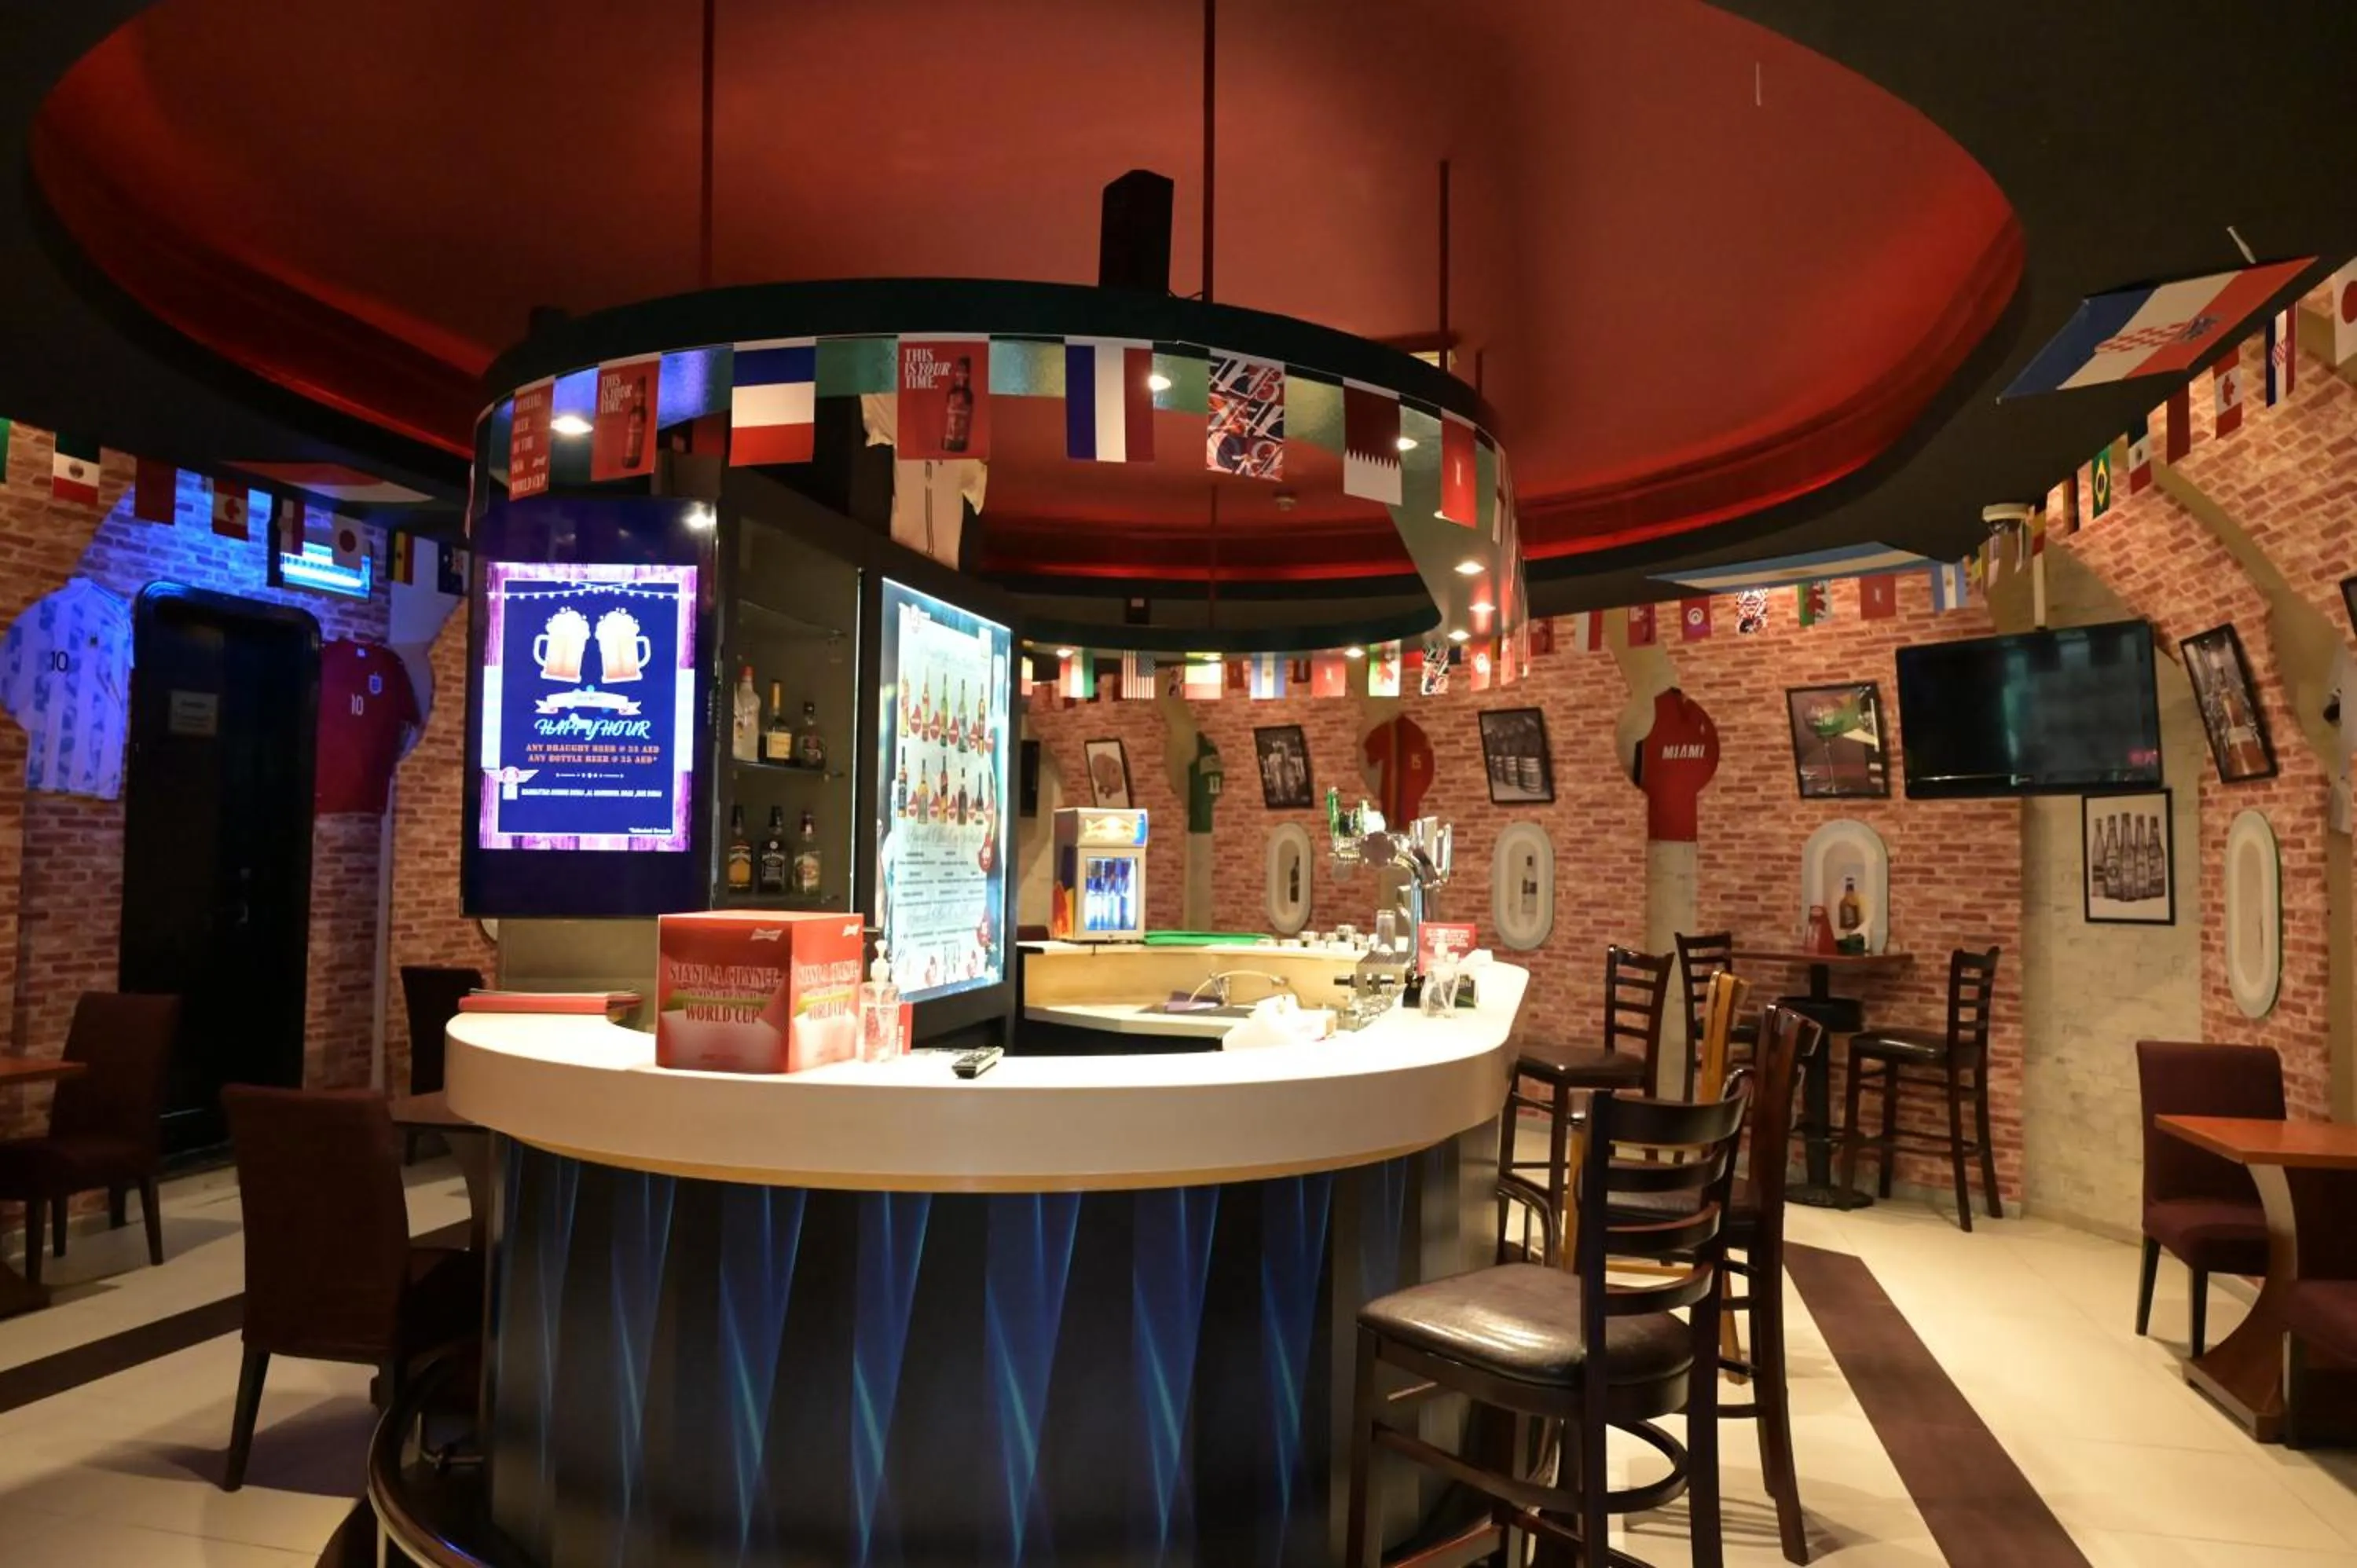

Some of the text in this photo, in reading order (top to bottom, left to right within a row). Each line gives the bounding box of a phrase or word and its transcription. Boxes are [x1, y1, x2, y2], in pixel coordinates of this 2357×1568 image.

[905, 348, 934, 362] THIS
[904, 361, 951, 376] IS YOUR
[601, 374, 621, 388] THIS
[905, 376, 939, 390] TIME.
[50, 650, 69, 672] 10
[350, 694, 364, 716] 10
[534, 719, 651, 741] HAPPY HOUR
[527, 754, 545, 763] ANY
[548, 754, 582, 763] BOTTLE
[1662, 744, 1706, 760] MIAMI
[685, 1005, 761, 1024] WORLD CUP
